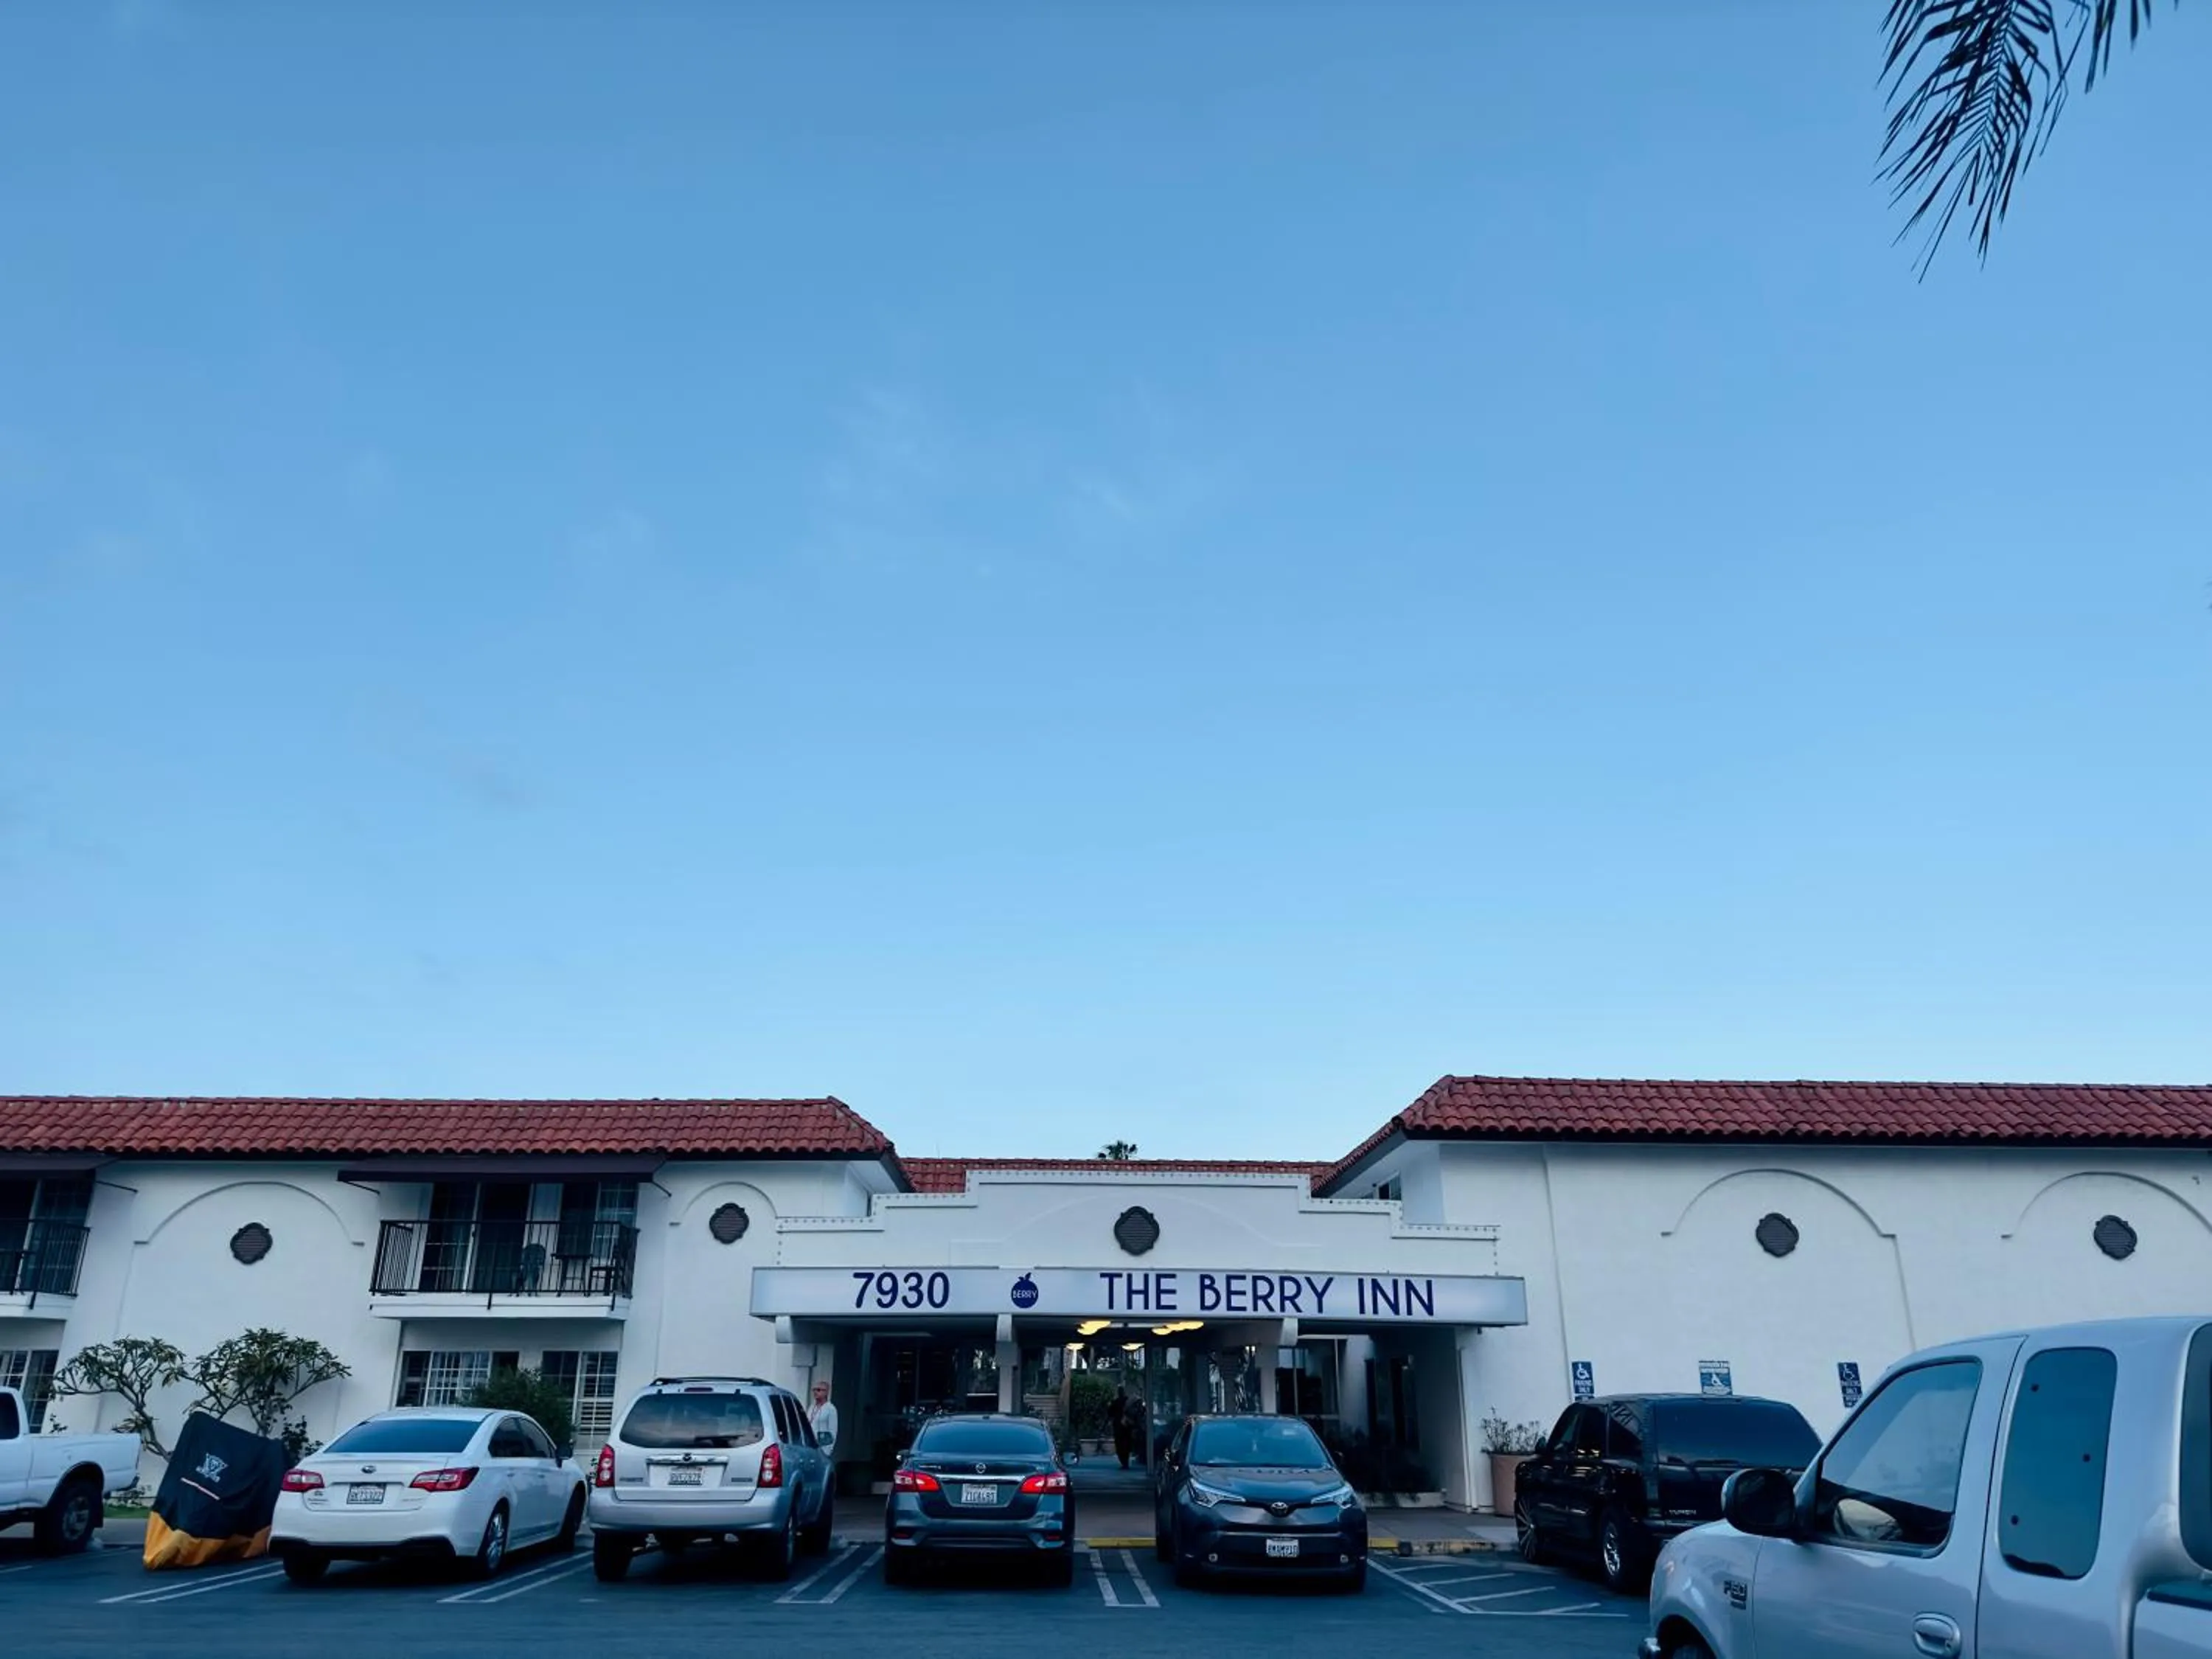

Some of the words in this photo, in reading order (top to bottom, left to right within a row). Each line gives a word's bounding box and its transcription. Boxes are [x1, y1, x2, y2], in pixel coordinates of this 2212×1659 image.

[852, 1271, 950, 1309] 7930
[1012, 1290, 1037, 1298] BERRY
[1099, 1273, 1178, 1310] THE
[1199, 1273, 1335, 1313] BERRY
[1357, 1278, 1435, 1316] INN
